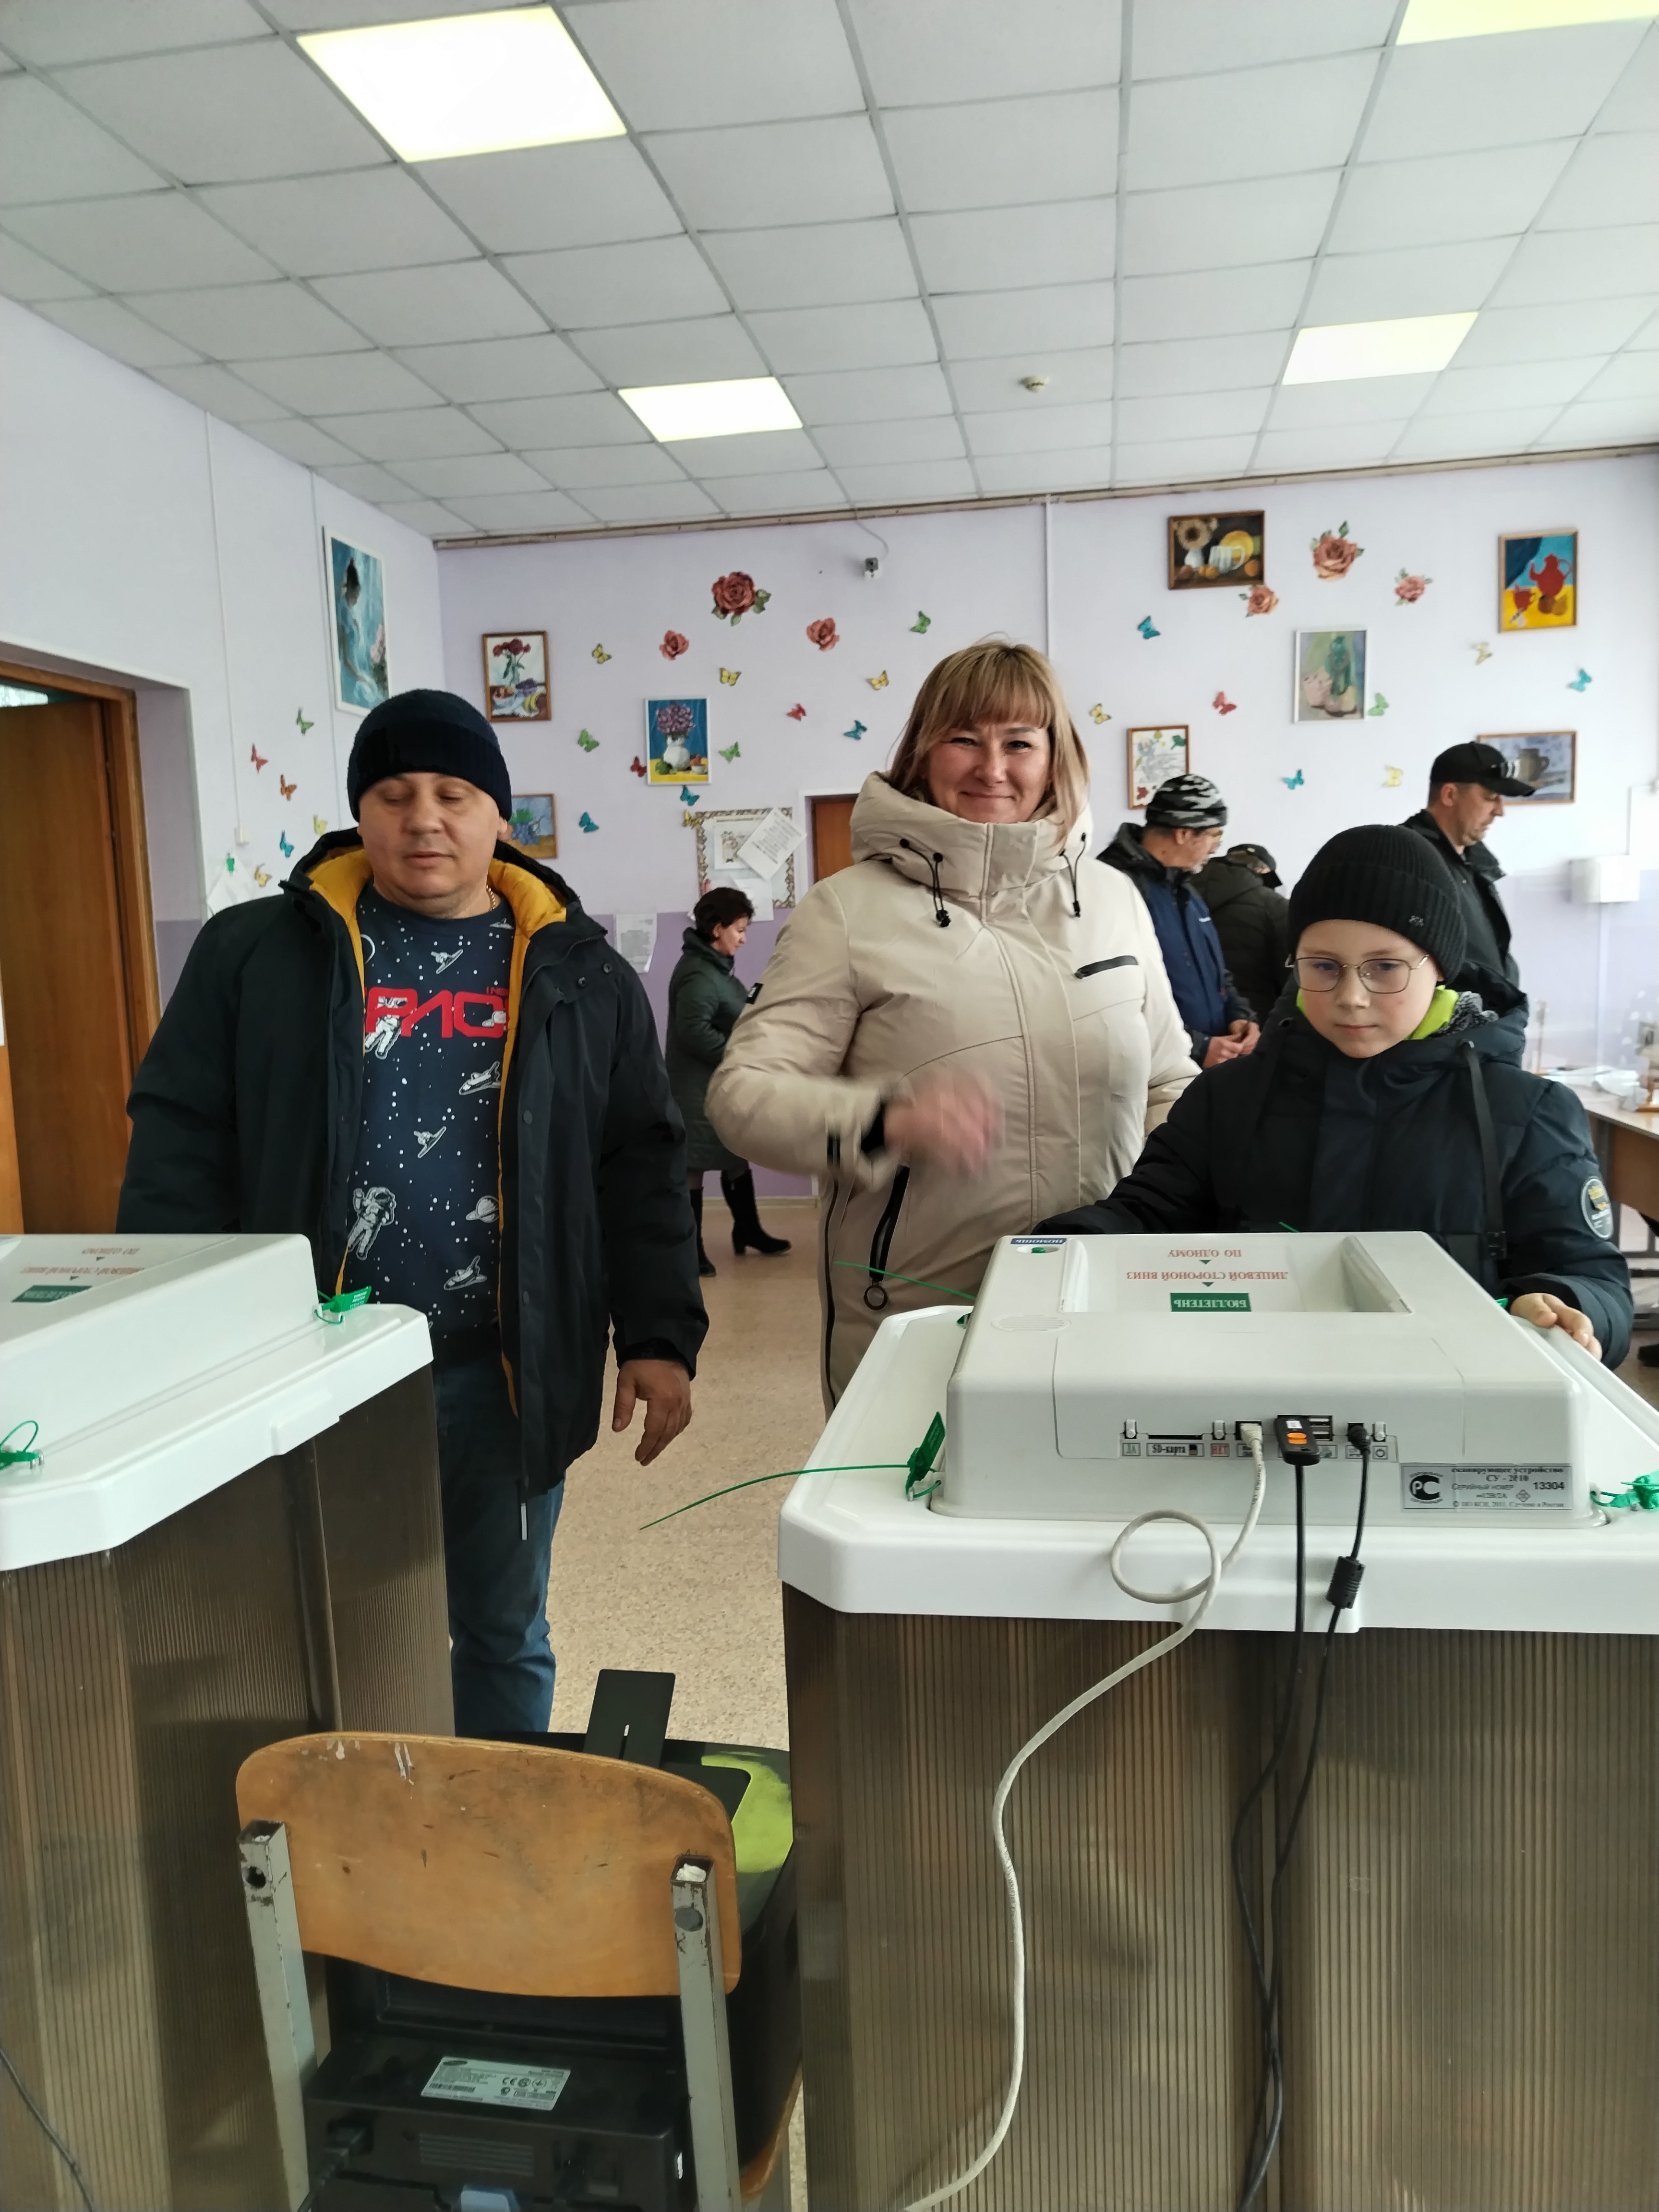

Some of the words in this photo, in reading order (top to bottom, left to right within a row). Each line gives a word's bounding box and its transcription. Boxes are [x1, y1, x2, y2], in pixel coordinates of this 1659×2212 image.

[364, 986, 509, 1039] PAC
[1167, 1249, 1219, 1257] ОДНОМУ
[1126, 1272, 1158, 1280] ВНИЗ
[1161, 1271, 1226, 1281] СТОРОНОЙ
[1229, 1271, 1288, 1281] ЛИЦЕВОЙ
[1173, 1299, 1247, 1308] БЮЛЛЕТЕНЬ
[1152, 1444, 1186, 1456] SD-карта
[1212, 1445, 1228, 1455] НЕТ
[1533, 1481, 1565, 1490] 13304
